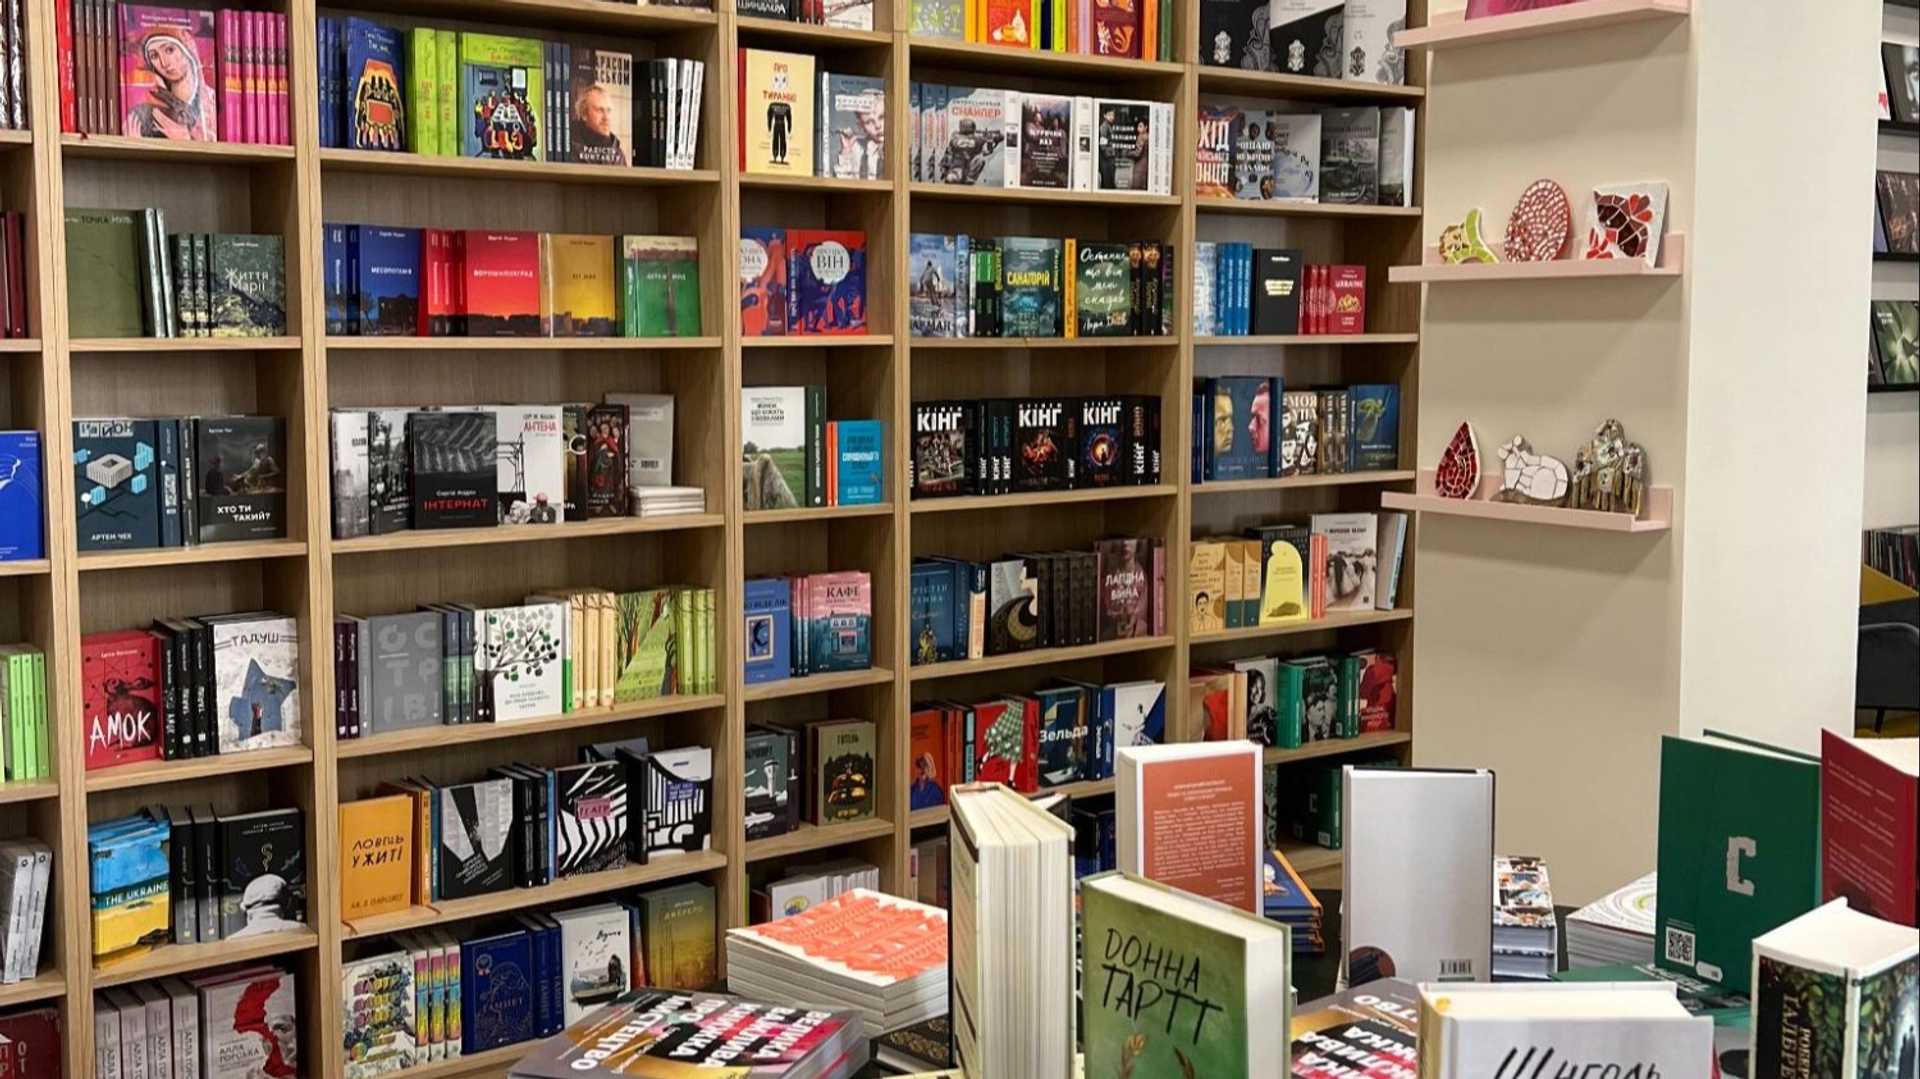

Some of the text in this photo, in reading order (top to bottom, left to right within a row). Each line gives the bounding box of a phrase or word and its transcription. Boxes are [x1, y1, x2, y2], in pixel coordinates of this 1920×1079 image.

[1198, 120, 1230, 151] ХІД
[1196, 162, 1230, 186] ОНЦЯ
[816, 255, 844, 269] ВІН
[225, 267, 269, 281] Життя
[1007, 270, 1050, 287] САНАТОРІЙ
[917, 410, 963, 432] КІНГ
[1018, 407, 1062, 428] КІНГ
[1082, 405, 1121, 426] КІНГ
[217, 504, 252, 515] ХТО ТИ
[424, 499, 489, 511] ІНТЕРНАТ
[232, 512, 271, 523] ТАКИЙ?
[230, 634, 280, 648] ТАДУШ
[89, 710, 151, 756] АМОК
[1039, 724, 1089, 744] Зельда
[362, 845, 404, 867] ЖИТІ
[105, 881, 169, 906] THE UKRAINE
[1105, 927, 1201, 993] ДОННА
[680, 998, 729, 1023] ПРО
[1102, 963, 1224, 1045] ТАРТТ
[571, 995, 694, 1071] МИСТЕЦТВО
[669, 1002, 762, 1058] КНИЖКА
[697, 1006, 796, 1068] ВАЖЛИВА
[752, 1010, 832, 1059] ВЕЛИКА
